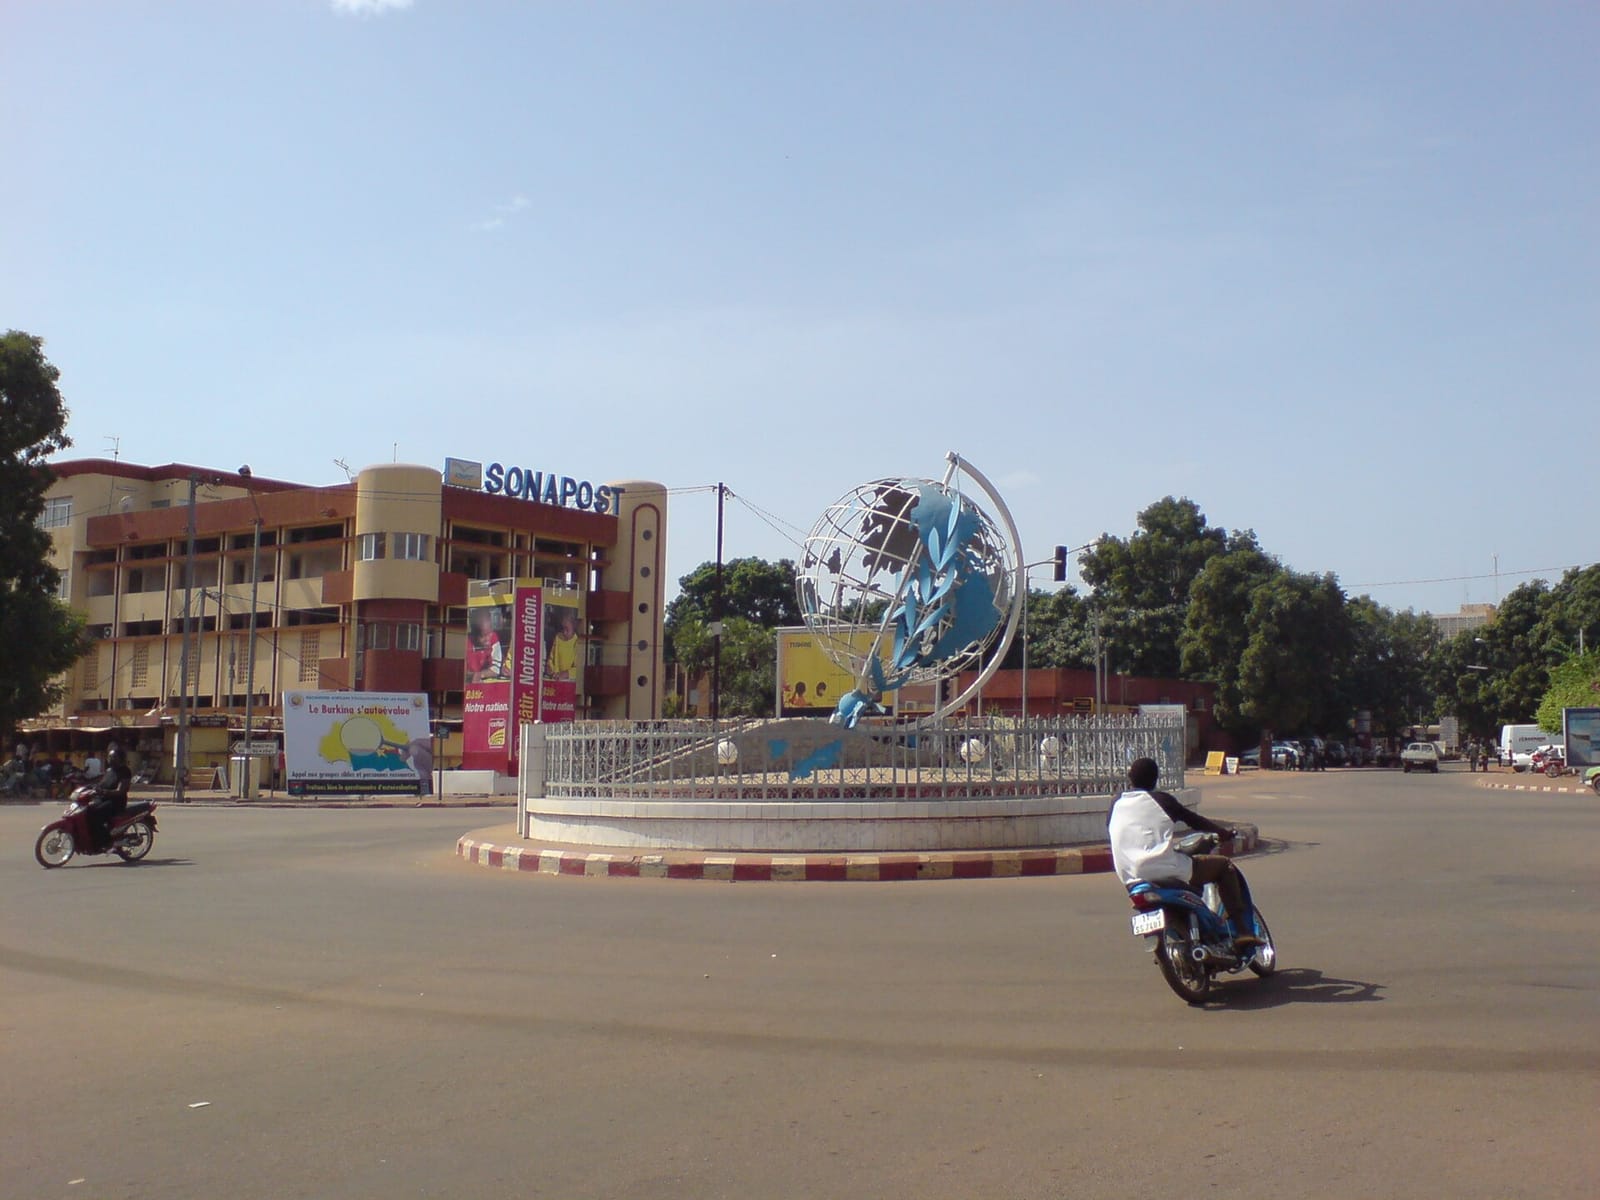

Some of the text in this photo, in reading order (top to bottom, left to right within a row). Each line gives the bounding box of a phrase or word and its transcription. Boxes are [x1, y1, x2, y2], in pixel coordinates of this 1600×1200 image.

[485, 463, 626, 515] SONAPOST
[521, 594, 537, 643] nation.
[519, 646, 535, 685] Notre
[309, 704, 318, 714] Le
[321, 703, 354, 714] Burkina
[464, 702, 509, 713] Notre nation.
